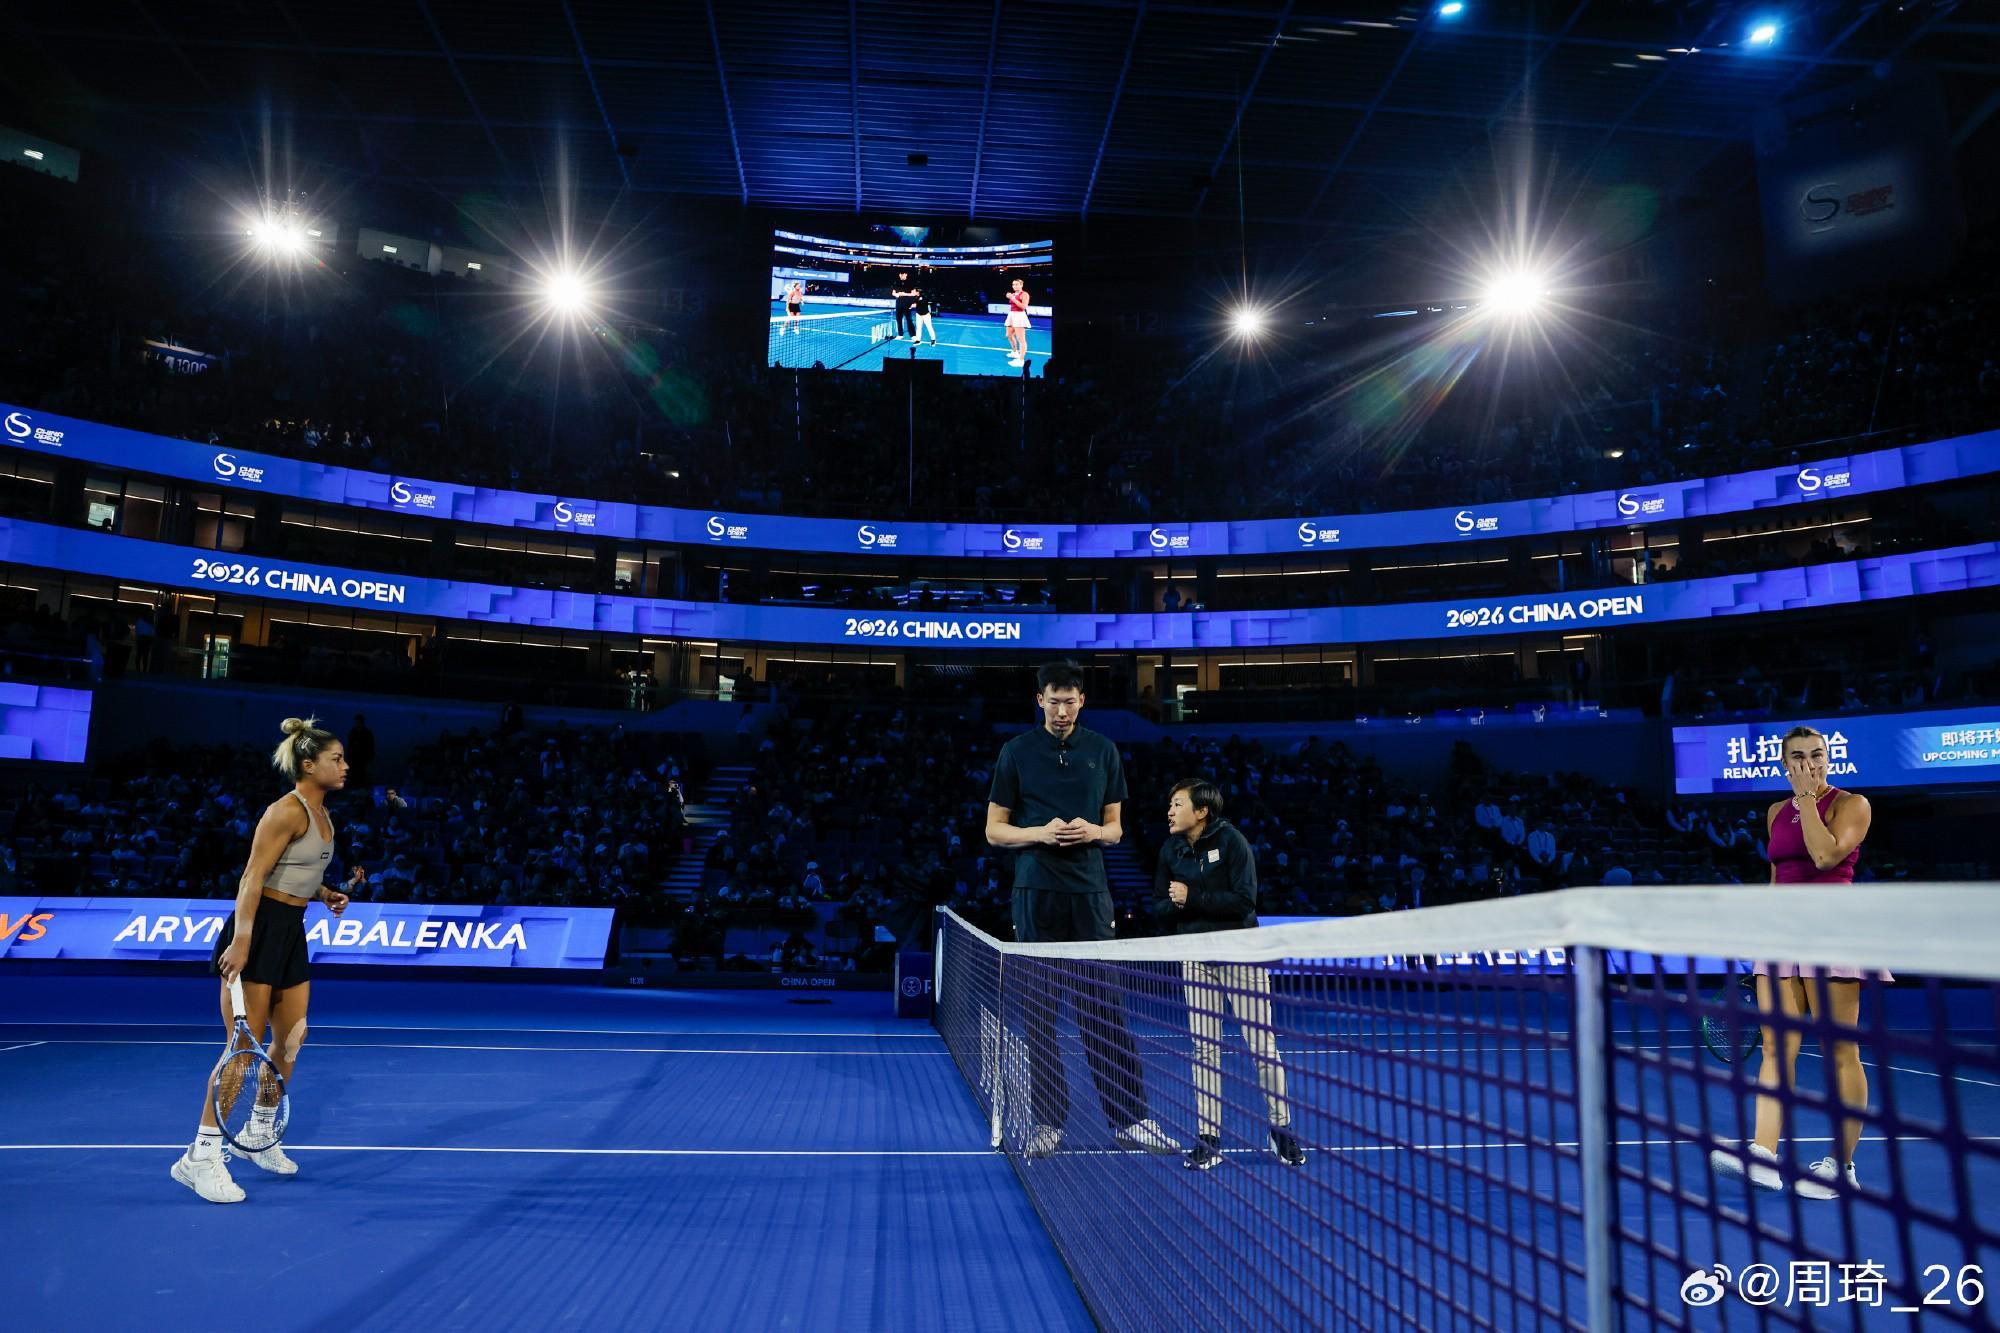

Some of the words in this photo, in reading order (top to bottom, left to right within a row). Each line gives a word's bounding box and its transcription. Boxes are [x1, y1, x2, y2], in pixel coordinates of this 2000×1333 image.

[191, 559, 260, 586] 2026
[265, 570, 337, 596] CHINA
[341, 579, 405, 603] OPEN
[1446, 606, 1504, 627] 2026
[1509, 602, 1577, 623] CHINA
[1579, 595, 1643, 618] OPEN
[845, 618, 899, 637] 2026
[903, 621, 963, 639] CHINA
[965, 622, 1020, 639] OPEN
[1727, 731, 1849, 763] 扎拉哈
[1922, 750, 1988, 762] UPCOMING
[1723, 766, 1781, 779] RENATA
[0, 913, 54, 941] VS
[303, 918, 528, 950] ABALENKA
[781, 978, 808, 986] CHINA
[811, 978, 835, 986] OPEN
